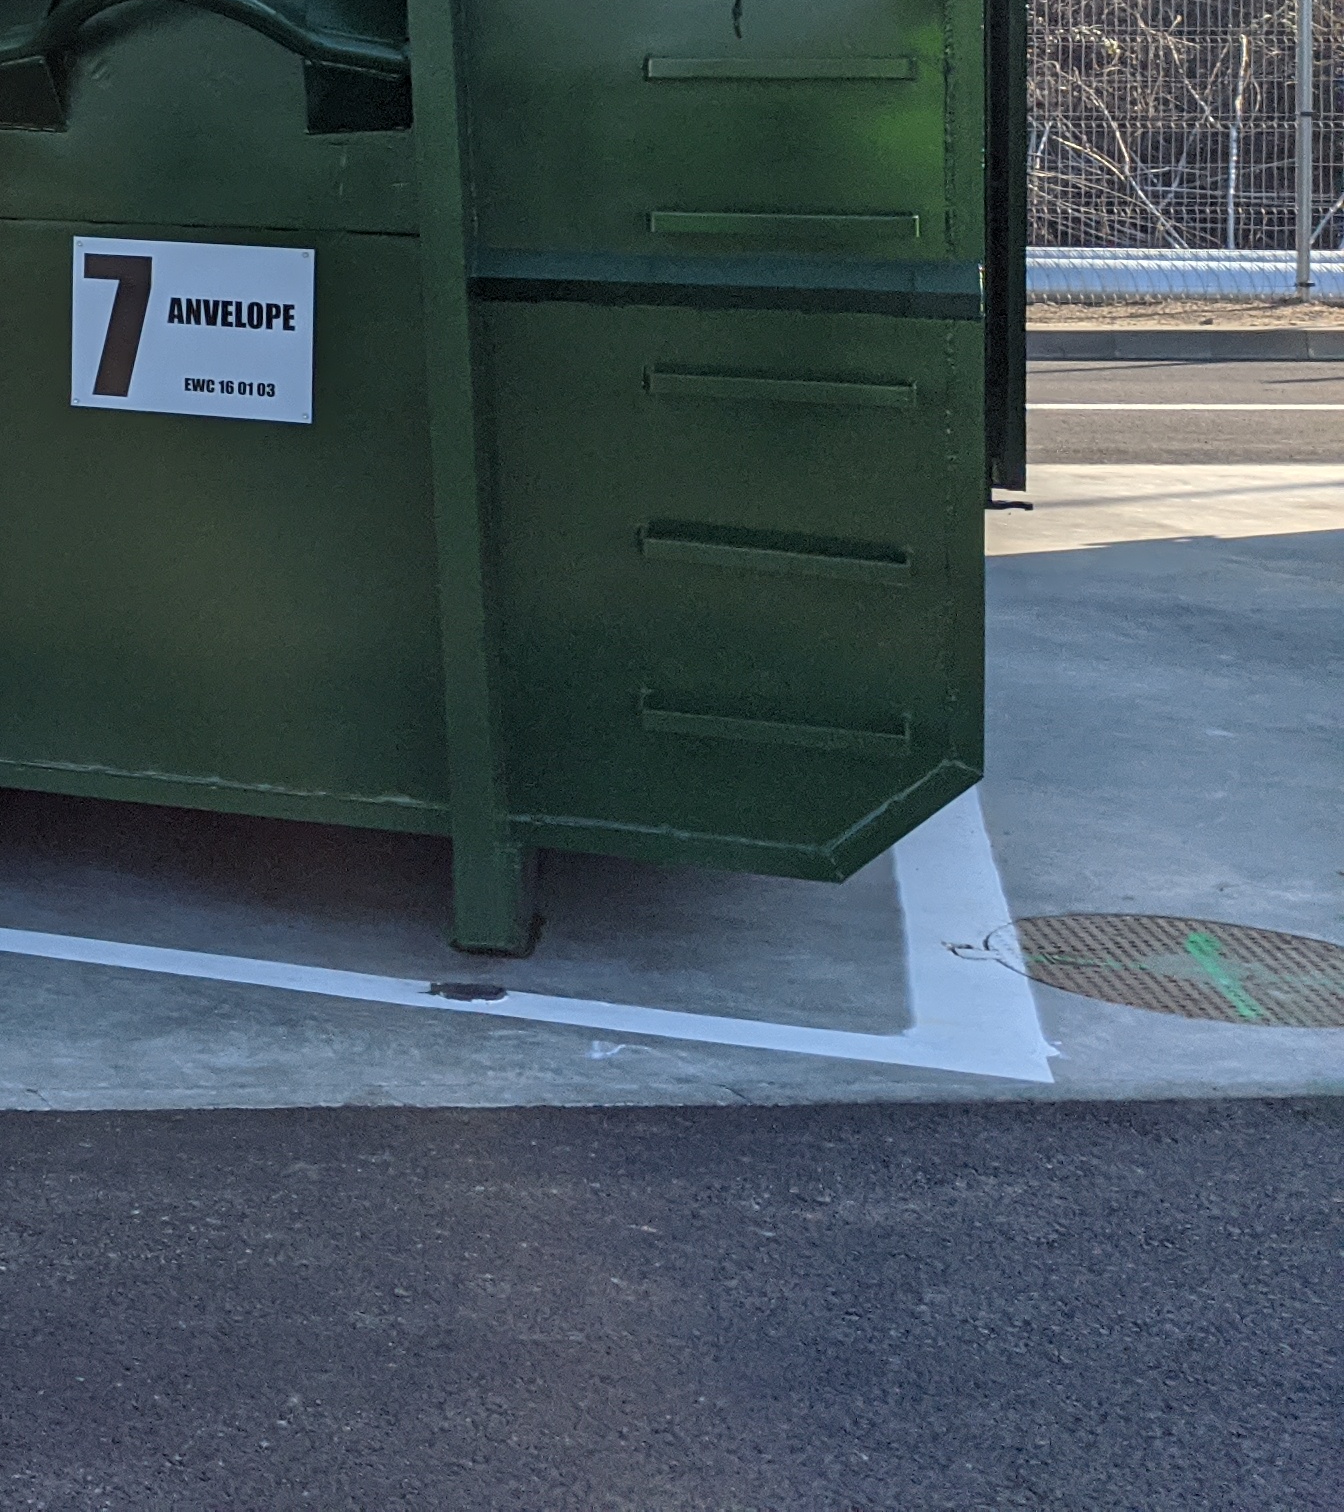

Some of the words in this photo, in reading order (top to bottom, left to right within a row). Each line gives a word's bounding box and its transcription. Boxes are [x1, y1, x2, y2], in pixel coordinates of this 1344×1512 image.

[83, 252, 153, 397] 7
[167, 297, 296, 331] ANVELOPE
[184, 378, 215, 393] EWC
[218, 380, 234, 395] 16
[237, 382, 253, 396] 01
[257, 383, 275, 397] 03
